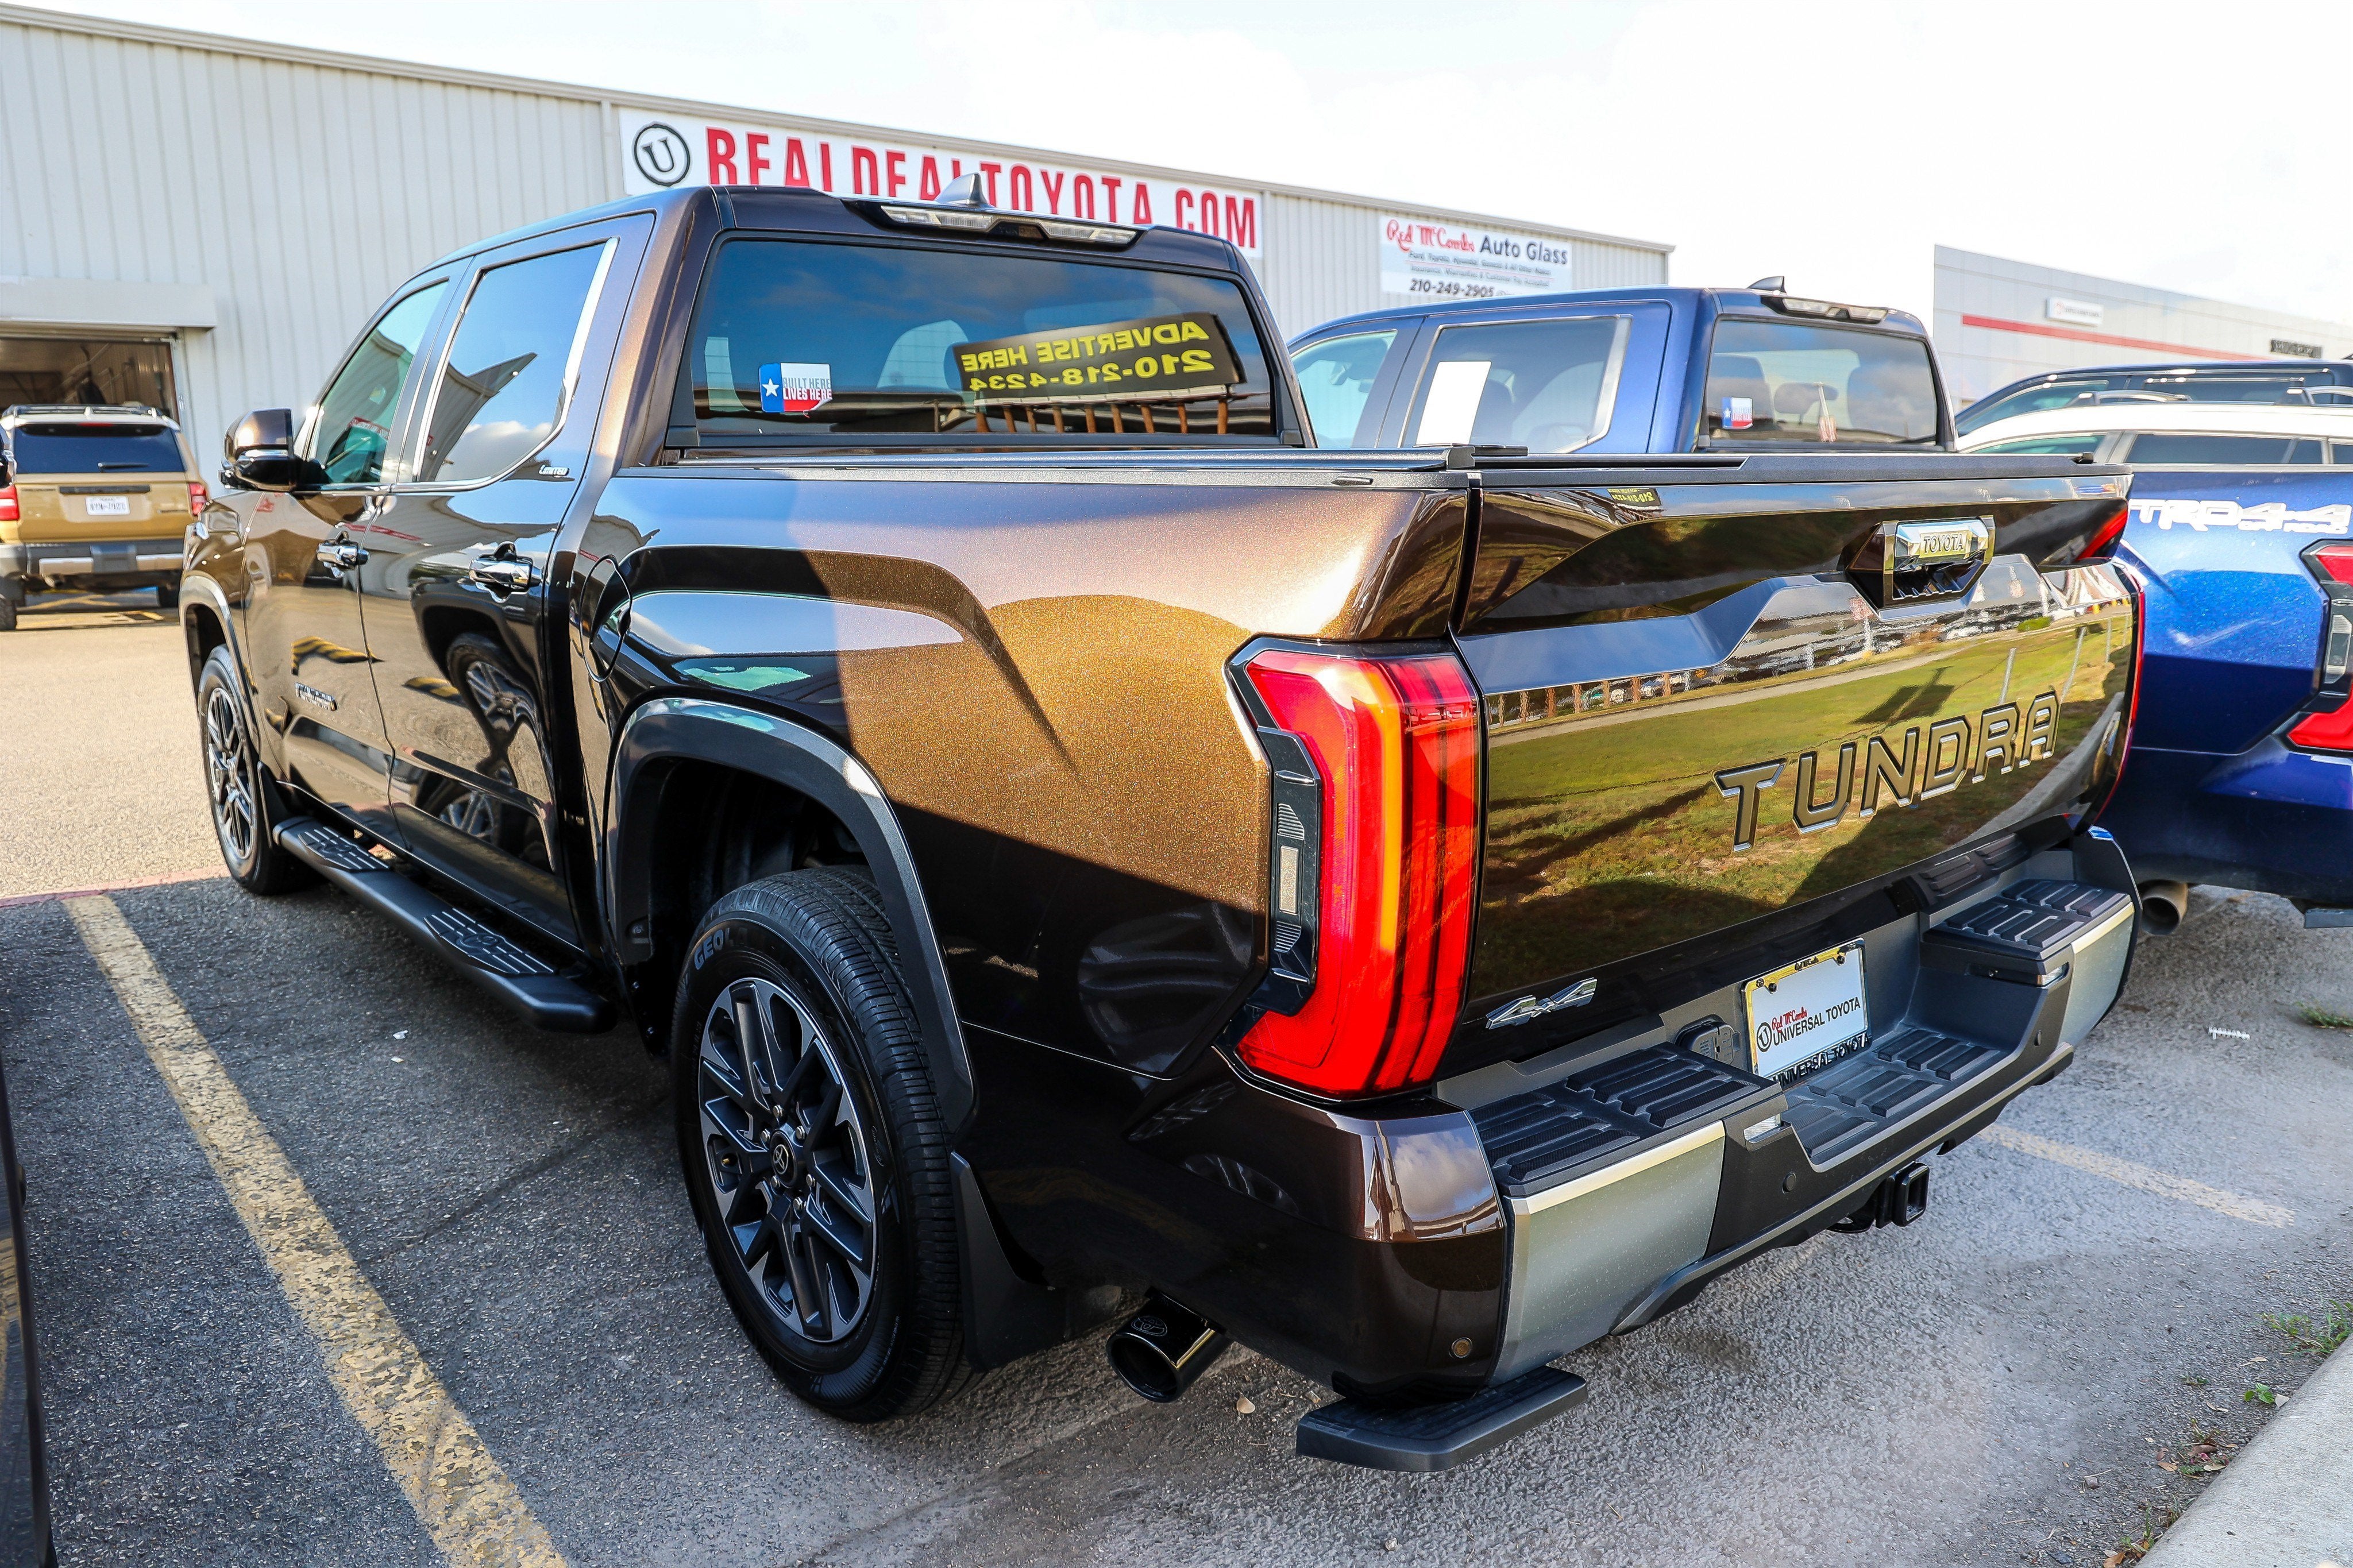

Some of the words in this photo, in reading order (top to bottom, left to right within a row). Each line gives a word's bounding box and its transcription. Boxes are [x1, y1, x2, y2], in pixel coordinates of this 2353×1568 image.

[1480, 234, 1521, 258] Auto
[1526, 241, 1568, 265] Glass
[782, 377, 807, 389] BUILT
[808, 377, 831, 389] HERE
[783, 387, 808, 400] LIVES
[809, 388, 832, 400] HERE
[1923, 534, 1965, 554] TOYOTA
[1711, 690, 2063, 852] TUNDRA
[1772, 1015, 1783, 1033] Red
[1773, 1013, 1826, 1046] UNIVERSAL
[1825, 997, 1861, 1022] TOYOTA
